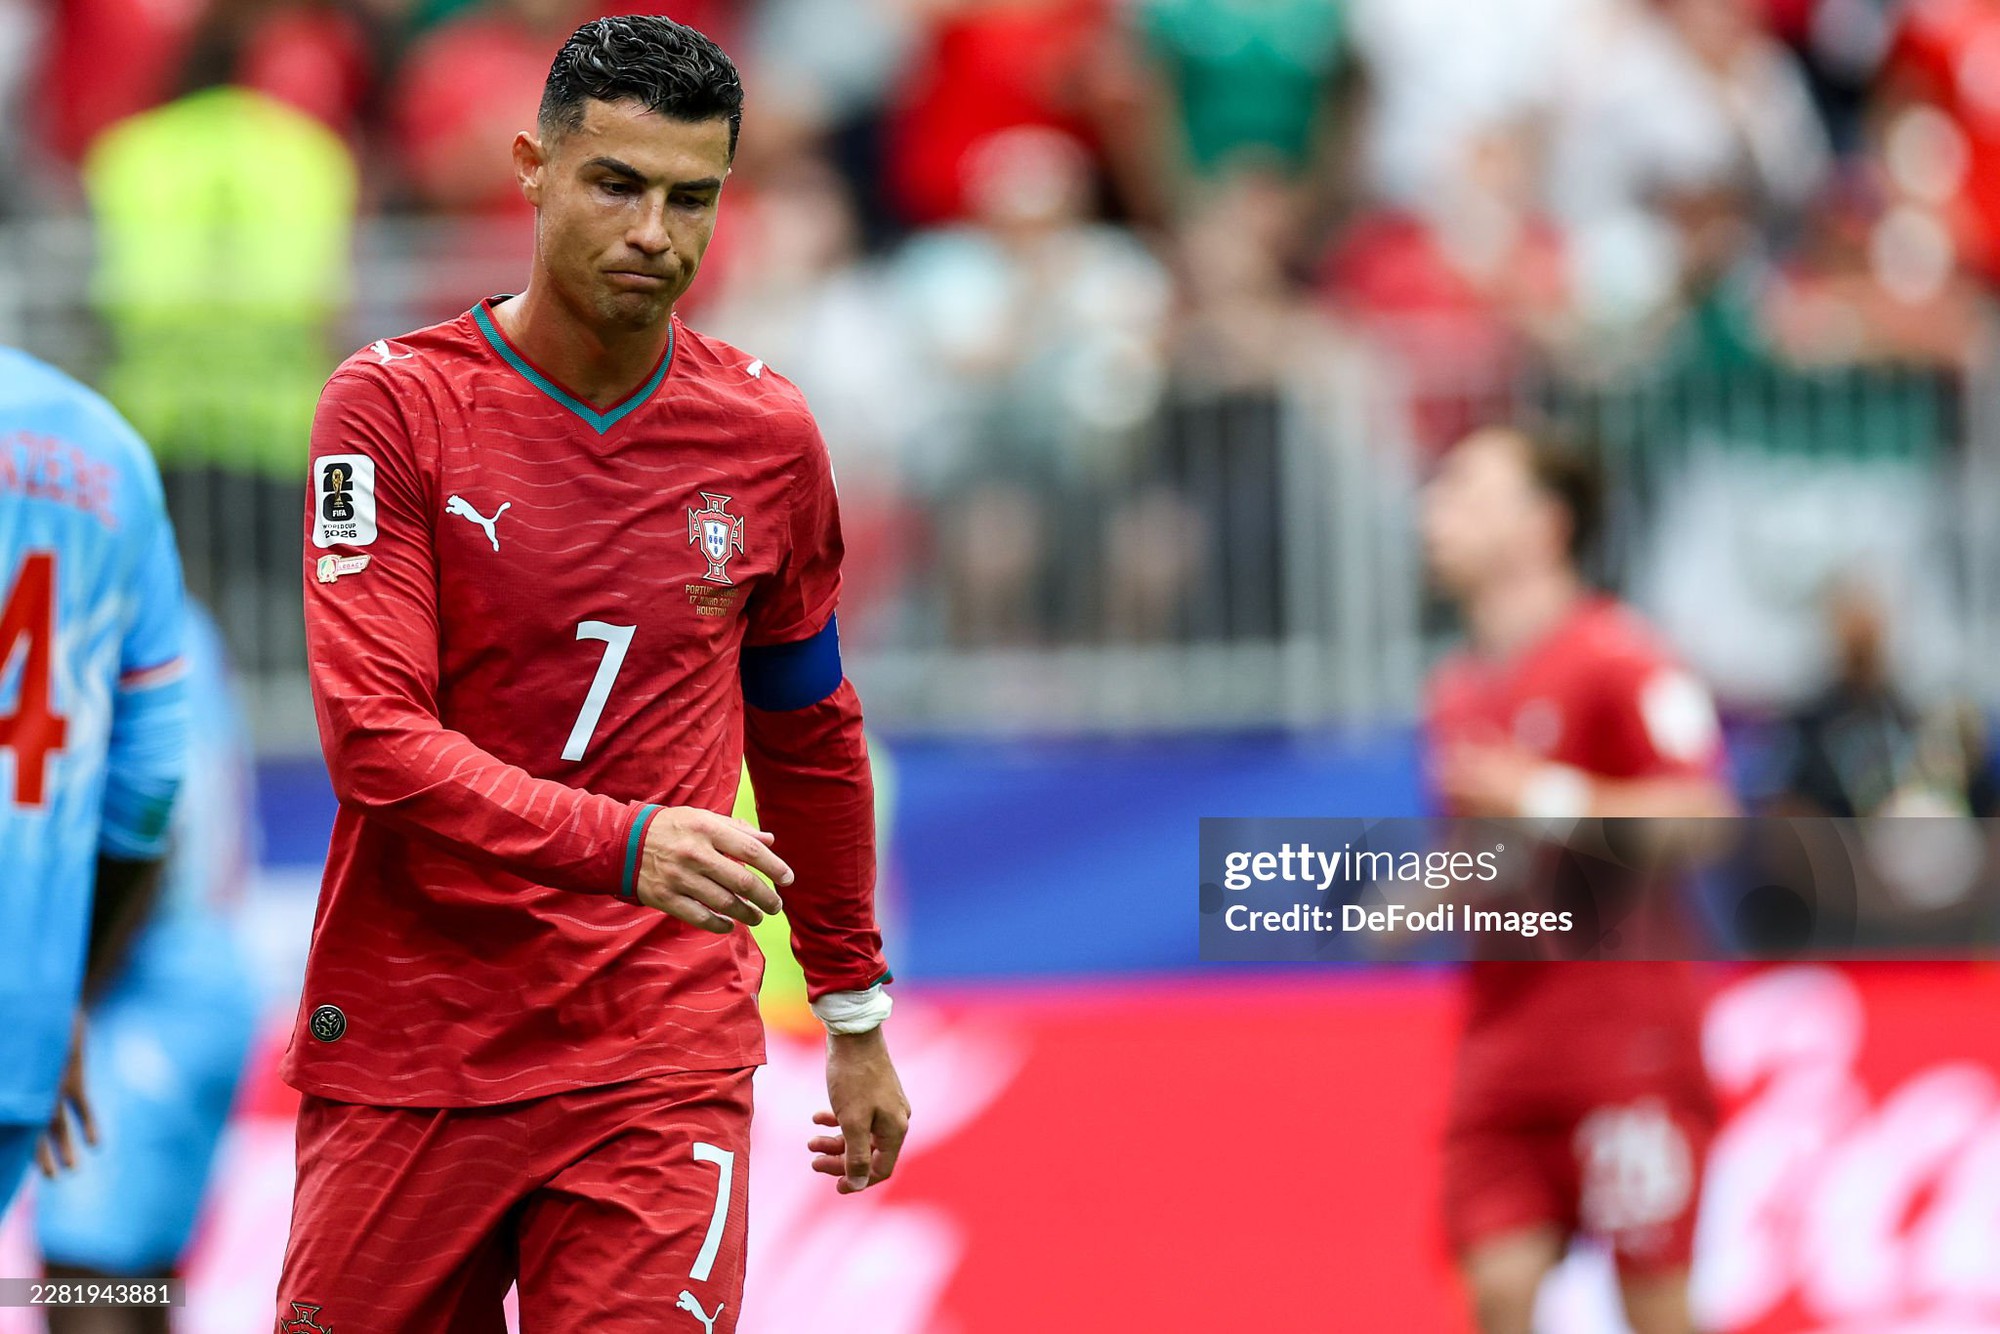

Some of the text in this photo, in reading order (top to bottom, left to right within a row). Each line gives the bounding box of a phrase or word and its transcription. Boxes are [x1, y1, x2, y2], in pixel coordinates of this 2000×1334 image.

[332, 509, 347, 517] FIFA
[324, 530, 357, 538] 2026
[696, 605, 727, 616] HOUSTON
[561, 620, 637, 761] 7
[689, 1142, 735, 1282] 7
